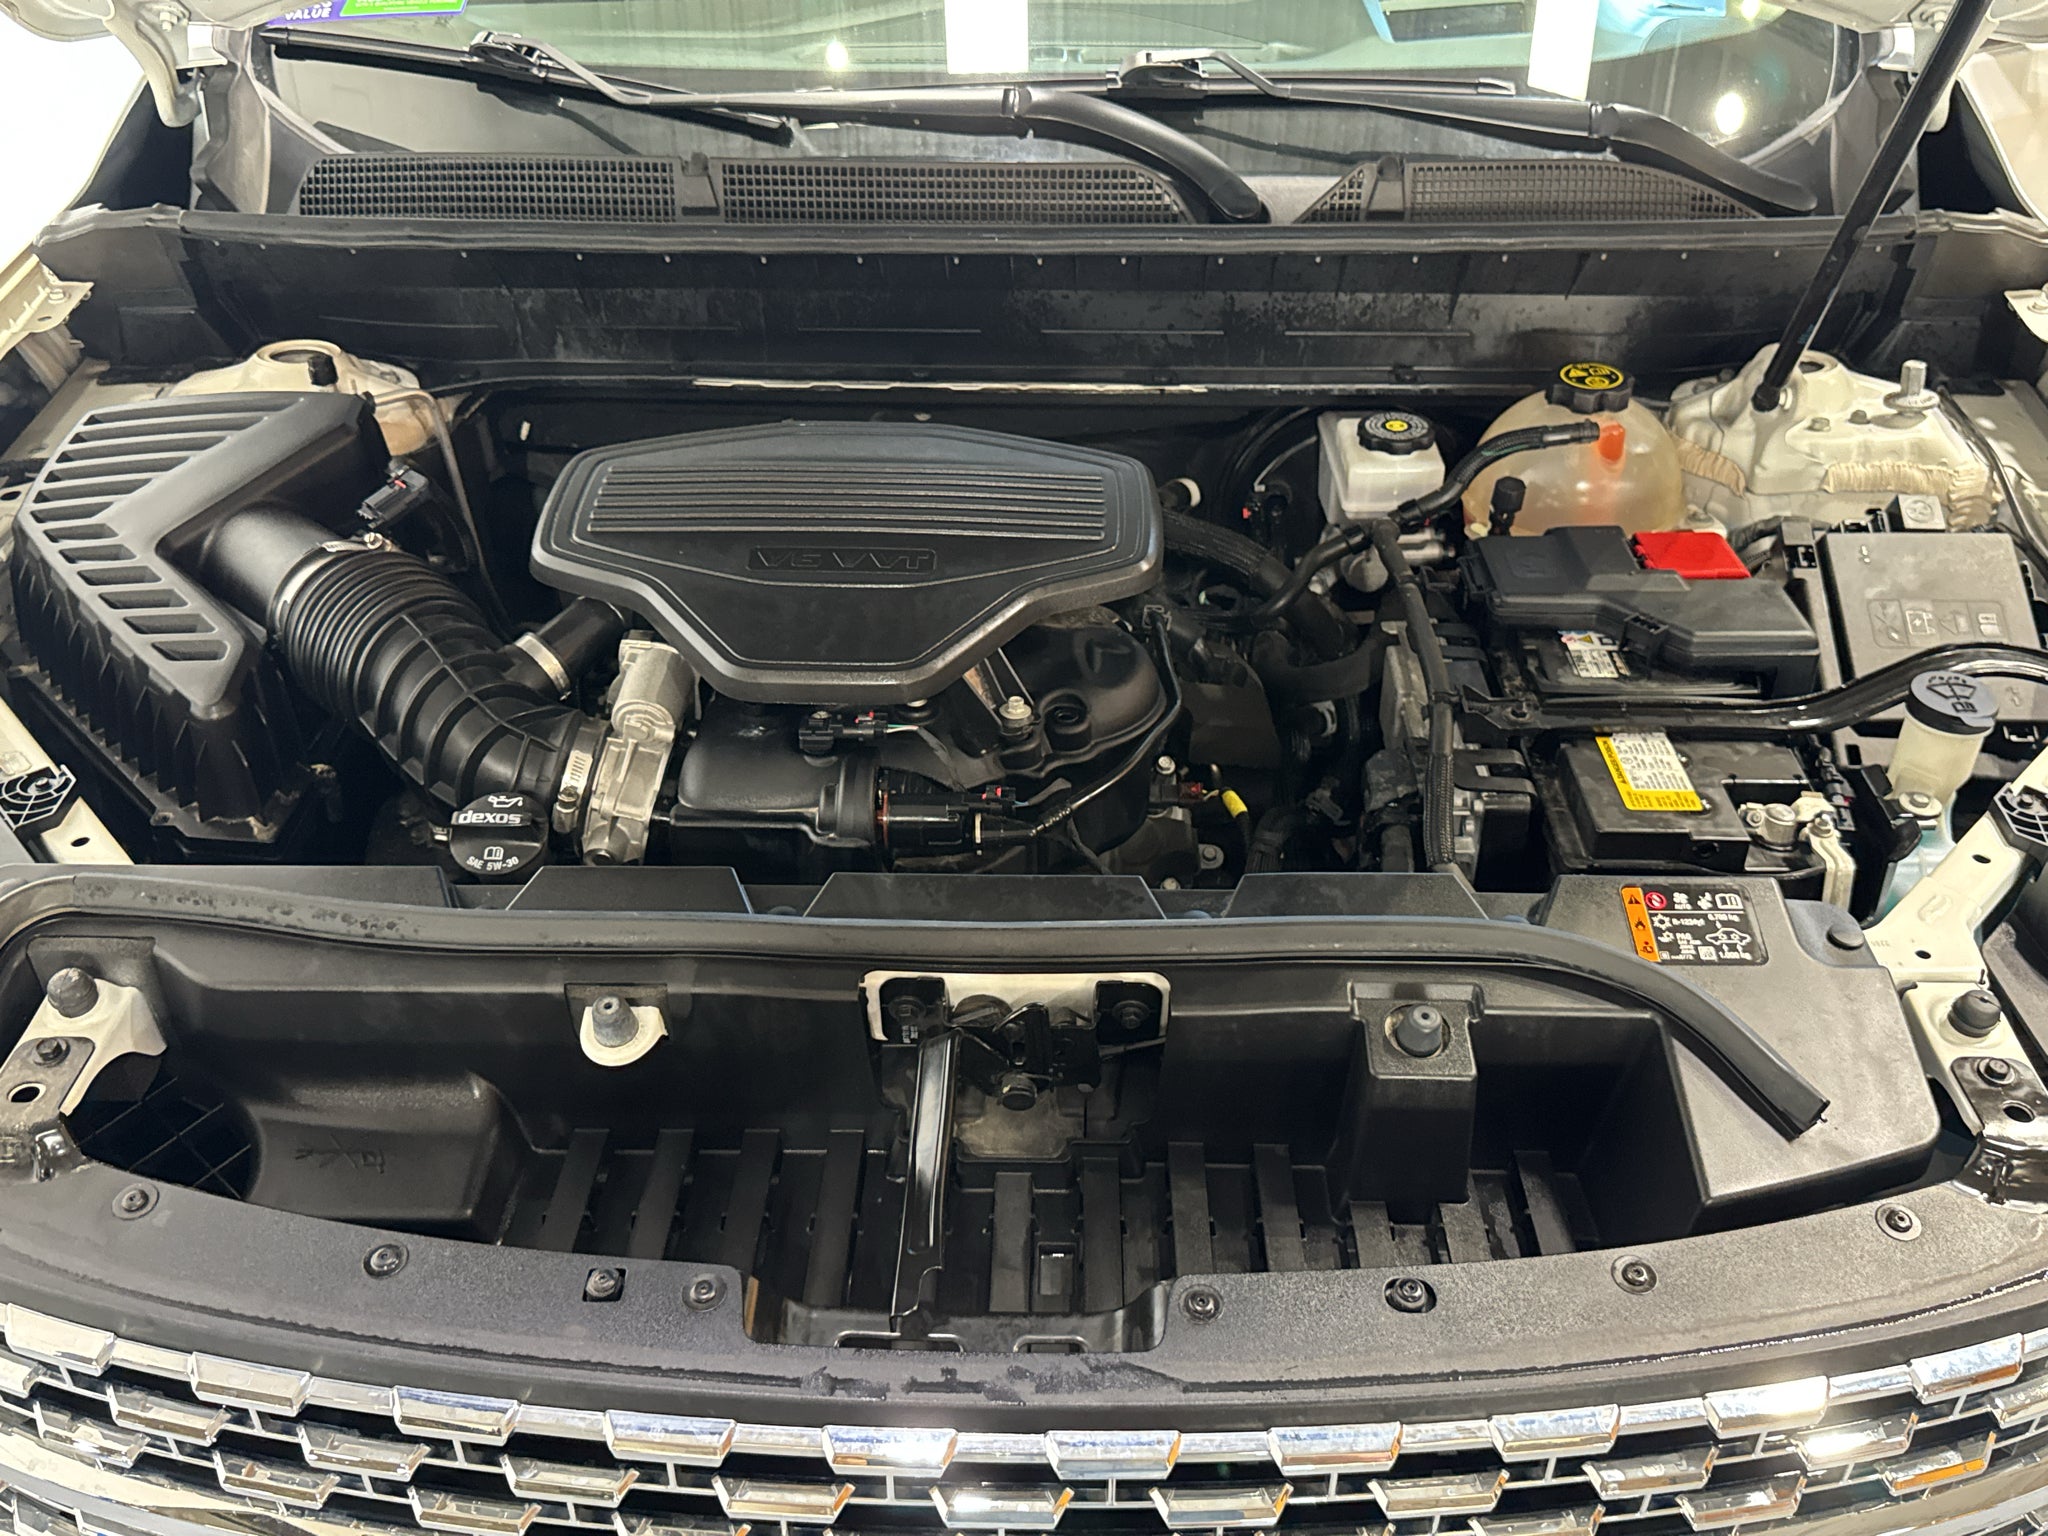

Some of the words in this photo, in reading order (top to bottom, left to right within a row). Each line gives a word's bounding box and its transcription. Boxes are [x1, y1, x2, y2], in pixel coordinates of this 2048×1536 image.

[285, 7, 332, 21] VALUE
[757, 550, 822, 568] V6
[832, 551, 930, 570] VVT
[458, 810, 523, 824] dexos
[466, 856, 483, 869] SAE
[486, 856, 519, 871] 5W-30
